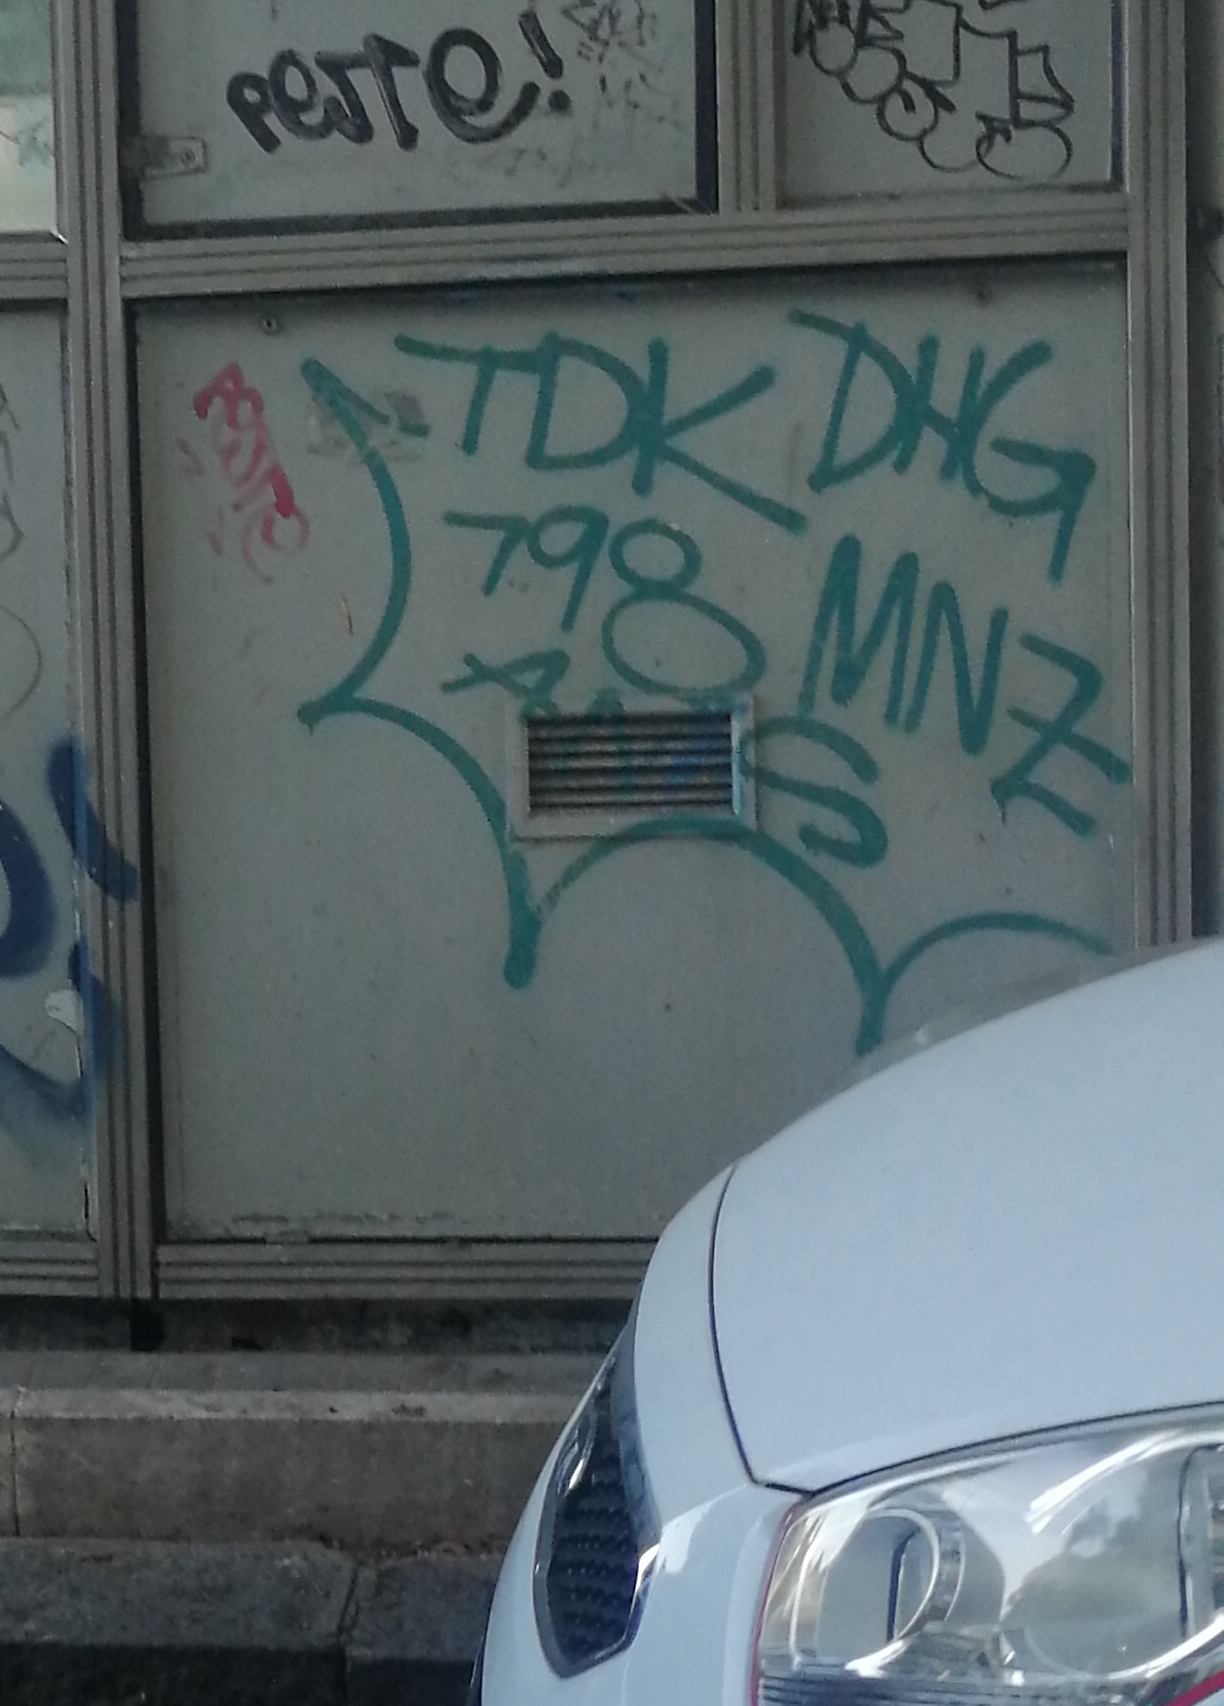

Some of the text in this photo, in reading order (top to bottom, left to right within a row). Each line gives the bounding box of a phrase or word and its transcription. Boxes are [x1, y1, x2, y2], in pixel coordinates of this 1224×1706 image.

[394, 308, 1097, 582] TDK DHG
[443, 504, 766, 700] 798
[797, 534, 1133, 837] MNZ
